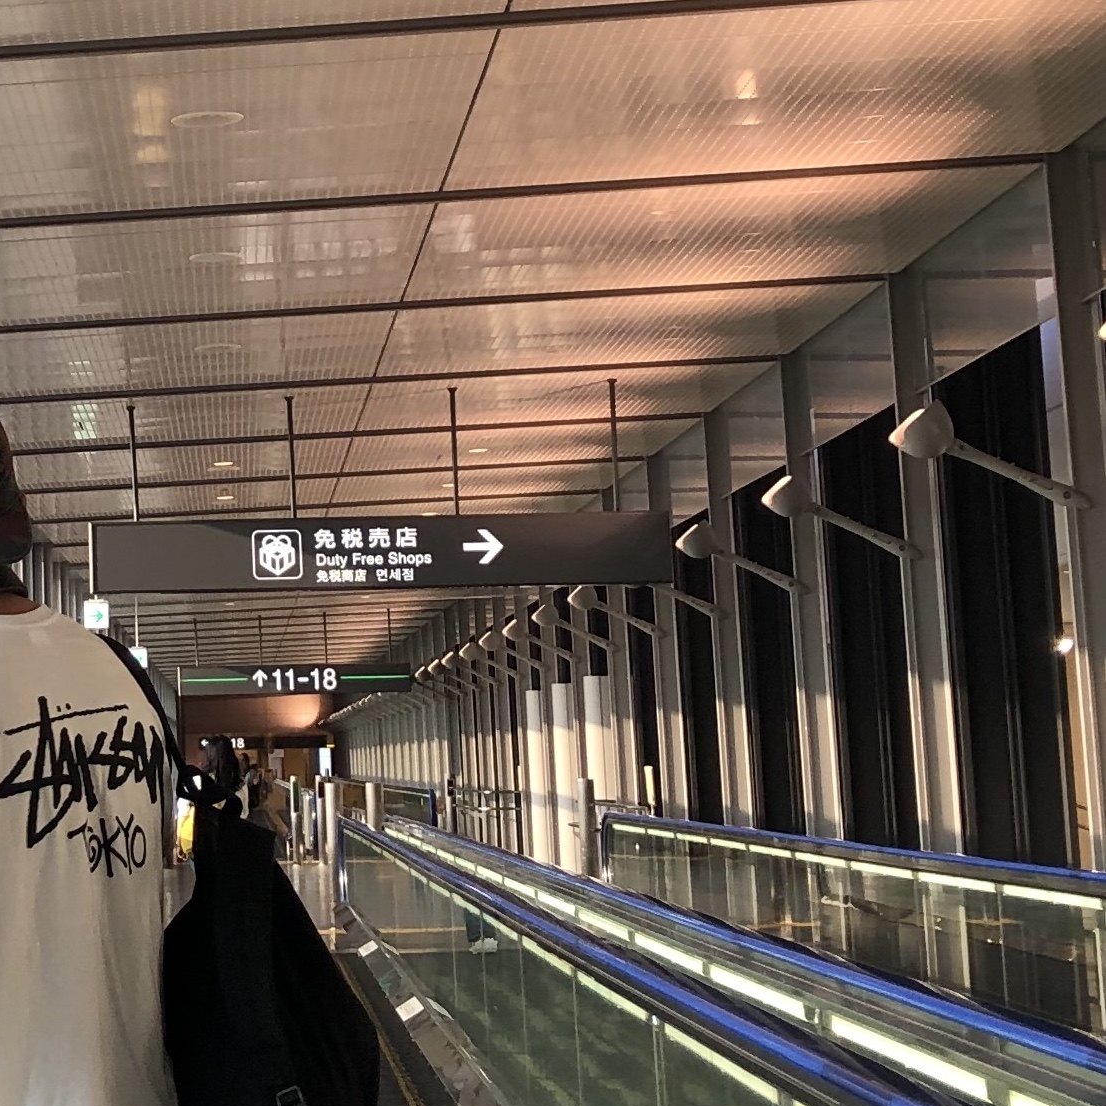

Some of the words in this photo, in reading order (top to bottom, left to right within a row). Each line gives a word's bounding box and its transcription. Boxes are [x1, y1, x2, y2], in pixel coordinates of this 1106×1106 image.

[314, 527, 417, 549] 免税売店
[316, 553, 347, 568] Duty
[352, 552, 383, 566] Free
[388, 551, 432, 567] Shops
[272, 667, 338, 691] 11-18
